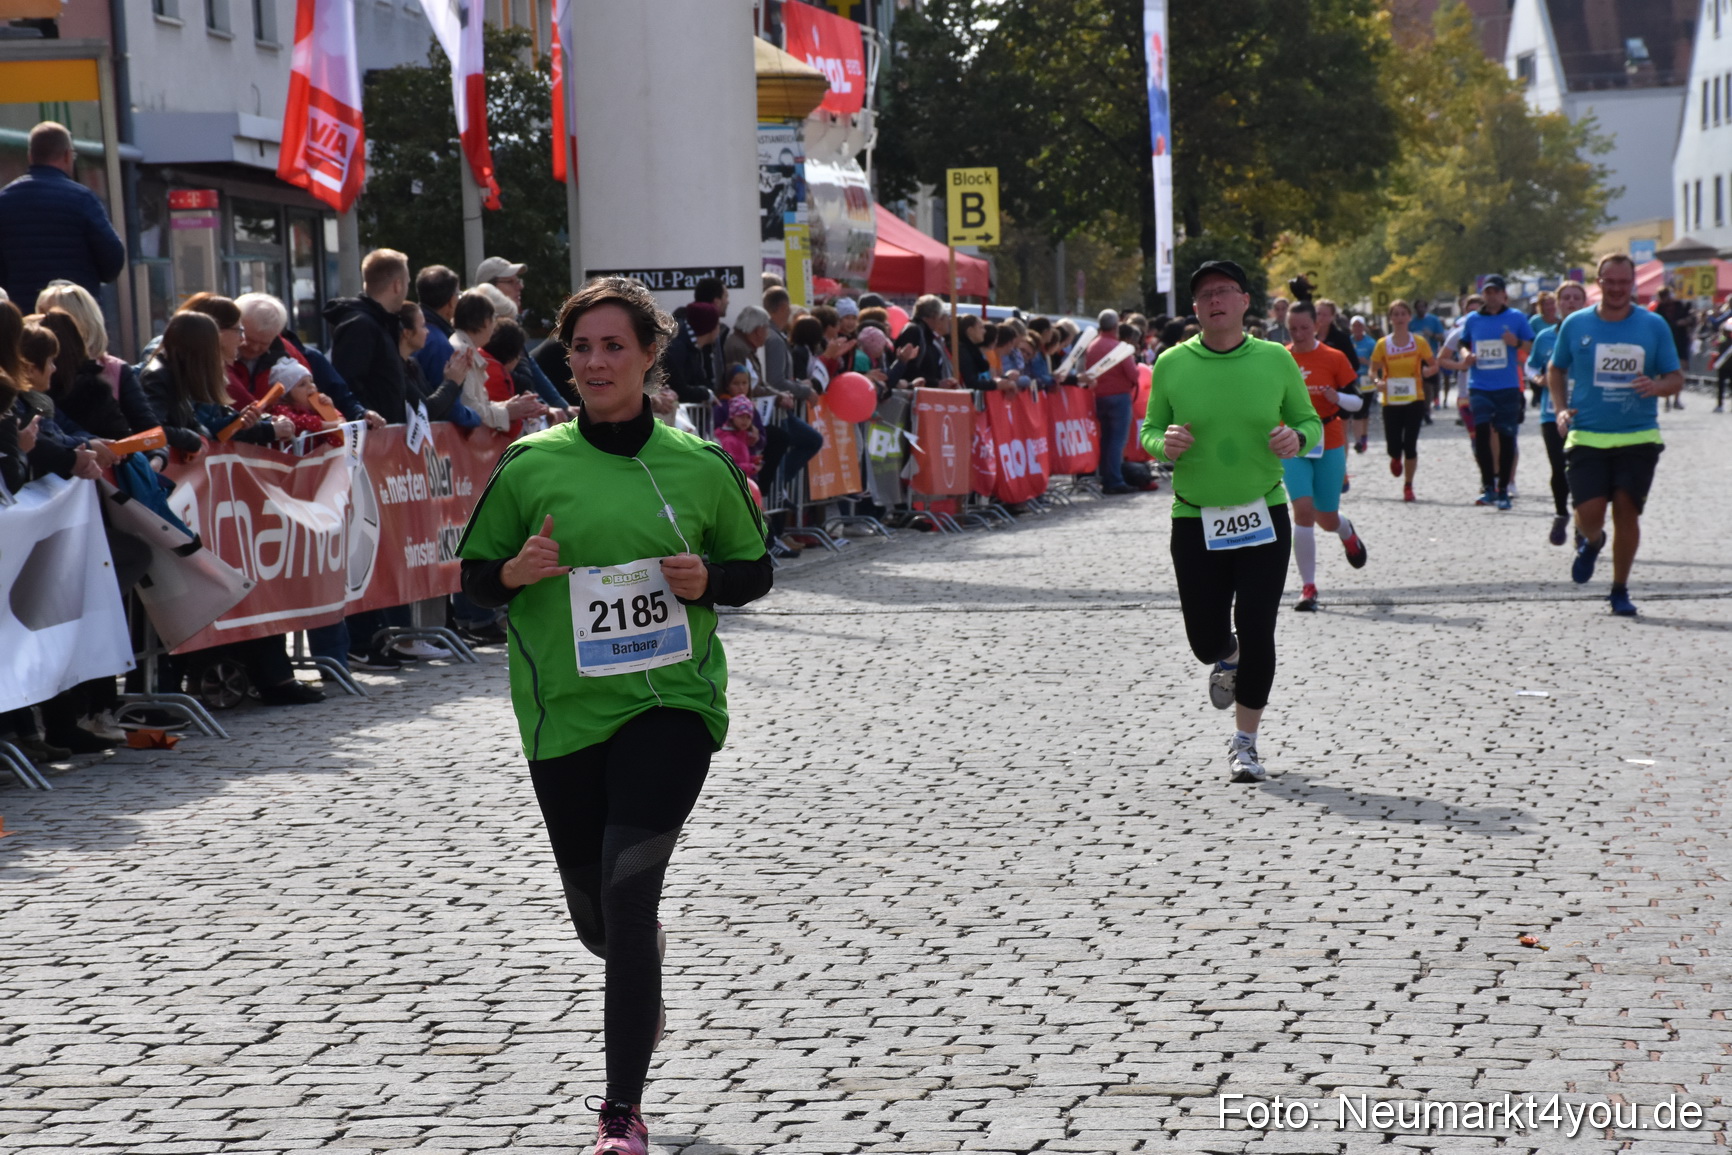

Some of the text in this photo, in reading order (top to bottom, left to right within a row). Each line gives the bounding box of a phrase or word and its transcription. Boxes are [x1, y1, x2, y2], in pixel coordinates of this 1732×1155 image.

[953, 170, 992, 186] Block
[961, 192, 986, 229] B
[1701, 273, 1714, 290] D
[1602, 357, 1637, 372] 2200
[1213, 511, 1262, 537] 2493
[614, 569, 649, 585] BOCK
[588, 589, 669, 634] 2185
[611, 637, 659, 656] Barbara
